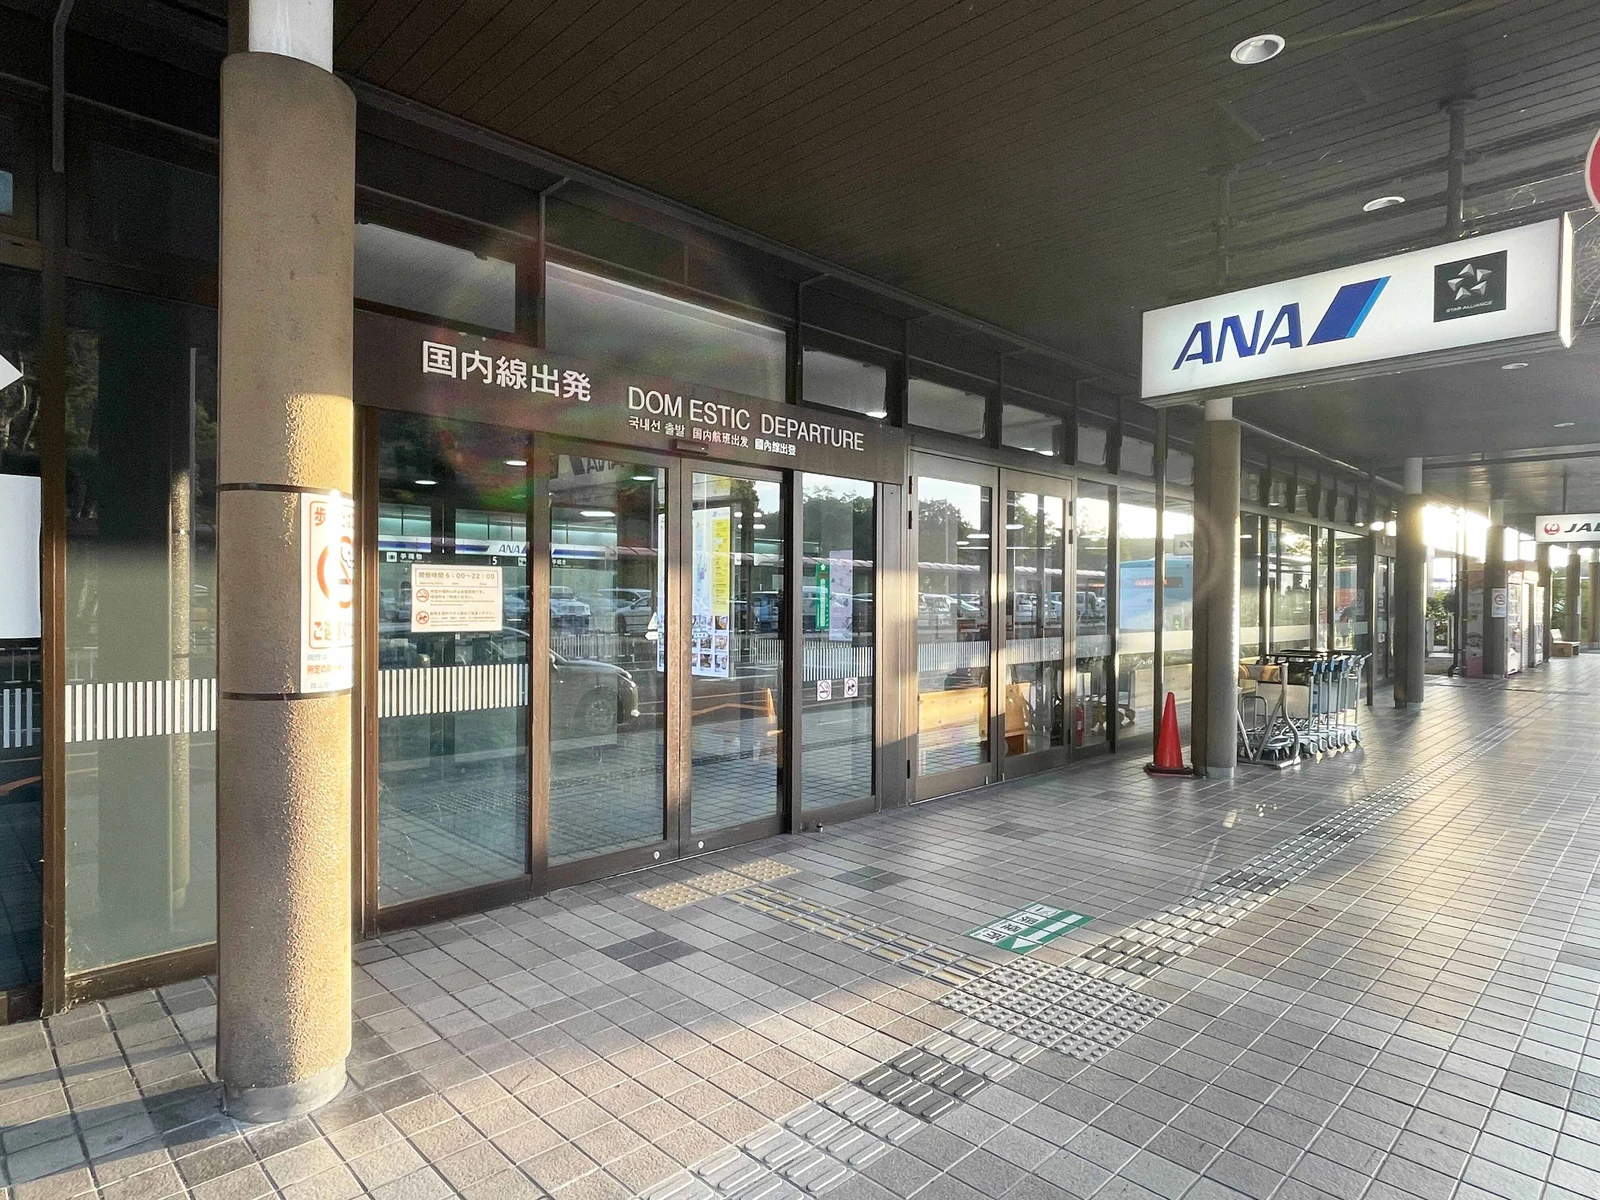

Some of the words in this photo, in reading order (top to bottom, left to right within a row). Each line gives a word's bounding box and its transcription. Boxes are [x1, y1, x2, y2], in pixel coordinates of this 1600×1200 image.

[1172, 302, 1303, 370] ANA
[422, 340, 591, 402] 国内線出発
[628, 416, 661, 434] 국내선
[664, 422, 686, 438] 출발
[692, 426, 749, 449] 国内航班出发
[760, 413, 865, 452] DEPARTURE
[498, 544, 521, 554] ANA
[492, 556, 498, 566] 5
